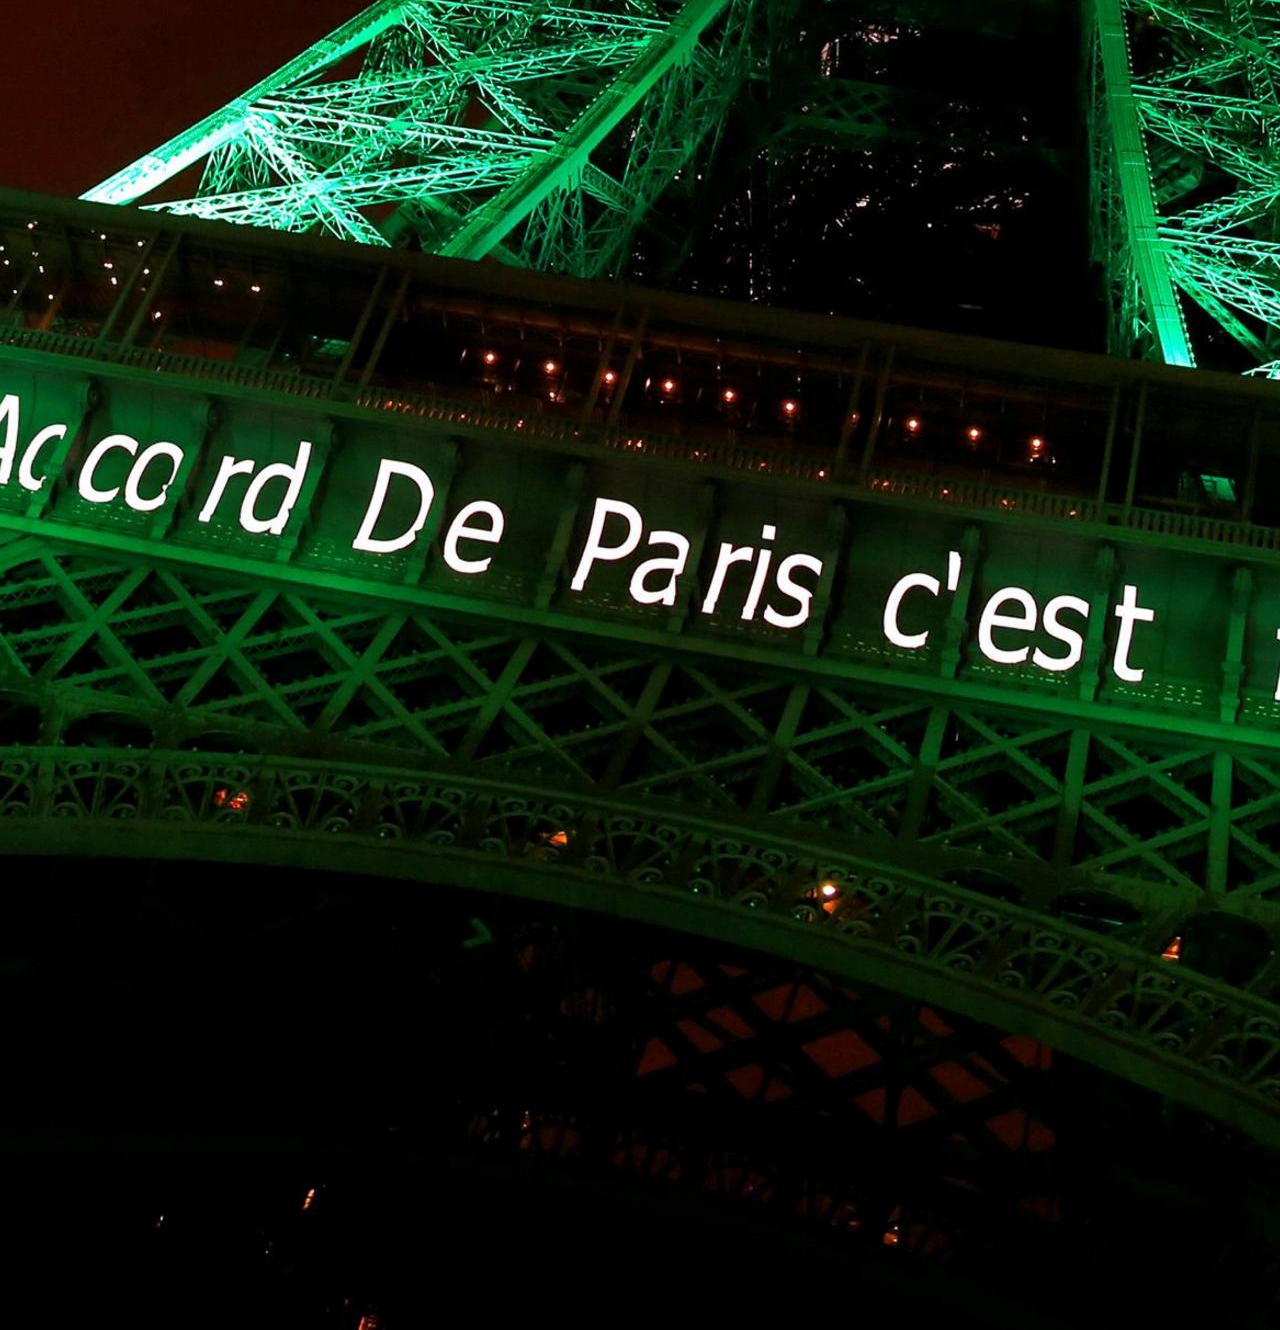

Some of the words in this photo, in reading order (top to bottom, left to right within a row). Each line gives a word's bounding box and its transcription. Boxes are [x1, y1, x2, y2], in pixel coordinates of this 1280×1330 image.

[353, 459, 503, 573] De
[571, 498, 822, 627] Paris
[883, 551, 1154, 681] c'est
